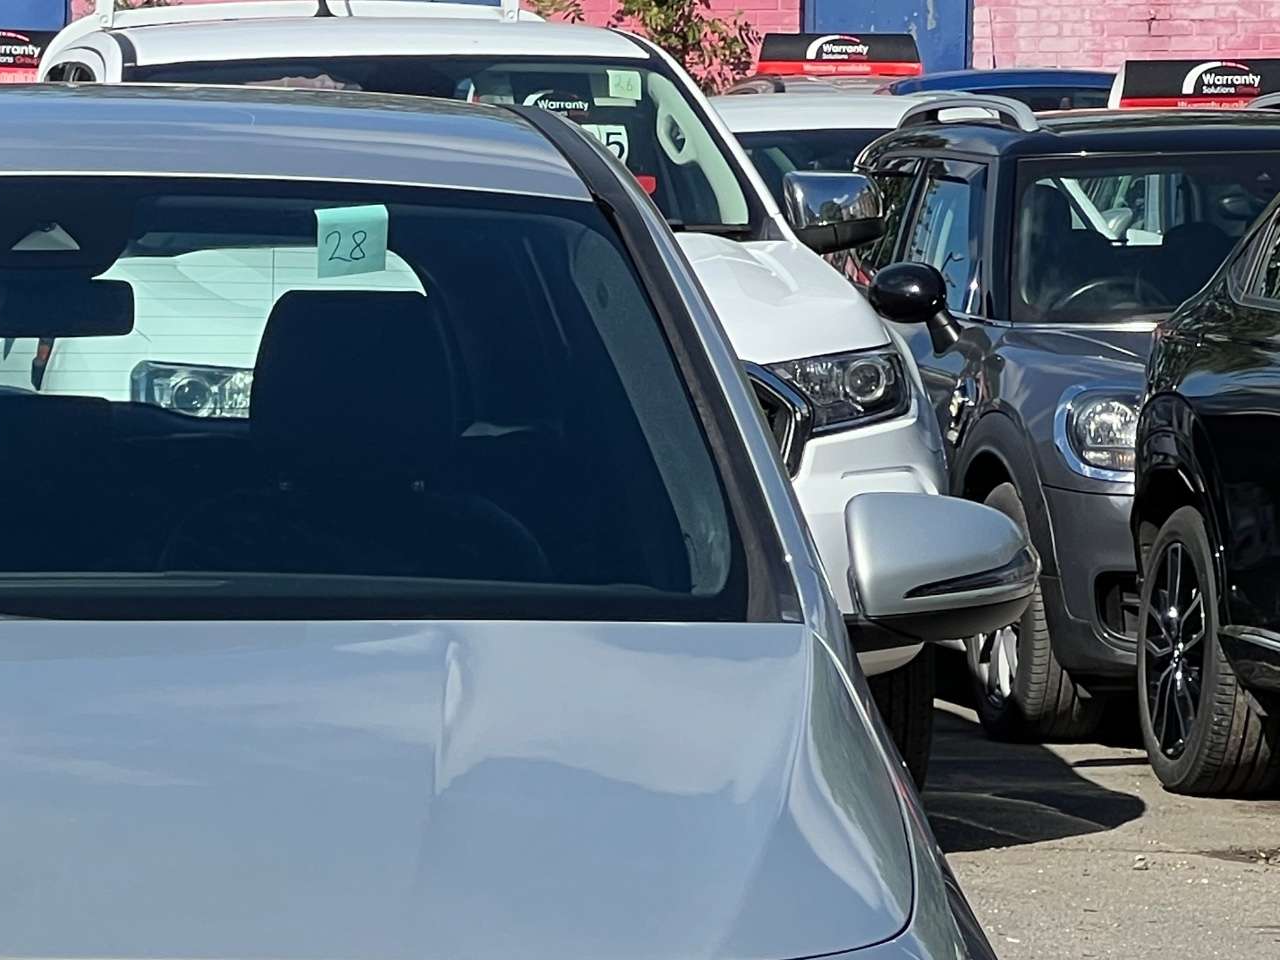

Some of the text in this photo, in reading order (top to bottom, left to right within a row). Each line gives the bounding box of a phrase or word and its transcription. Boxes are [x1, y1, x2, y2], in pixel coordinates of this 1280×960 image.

[822, 43, 869, 56] Warranty
[1202, 73, 1260, 87] Warranty
[538, 100, 588, 111] Warranty
[606, 132, 625, 159] 5
[325, 230, 367, 262] 28
